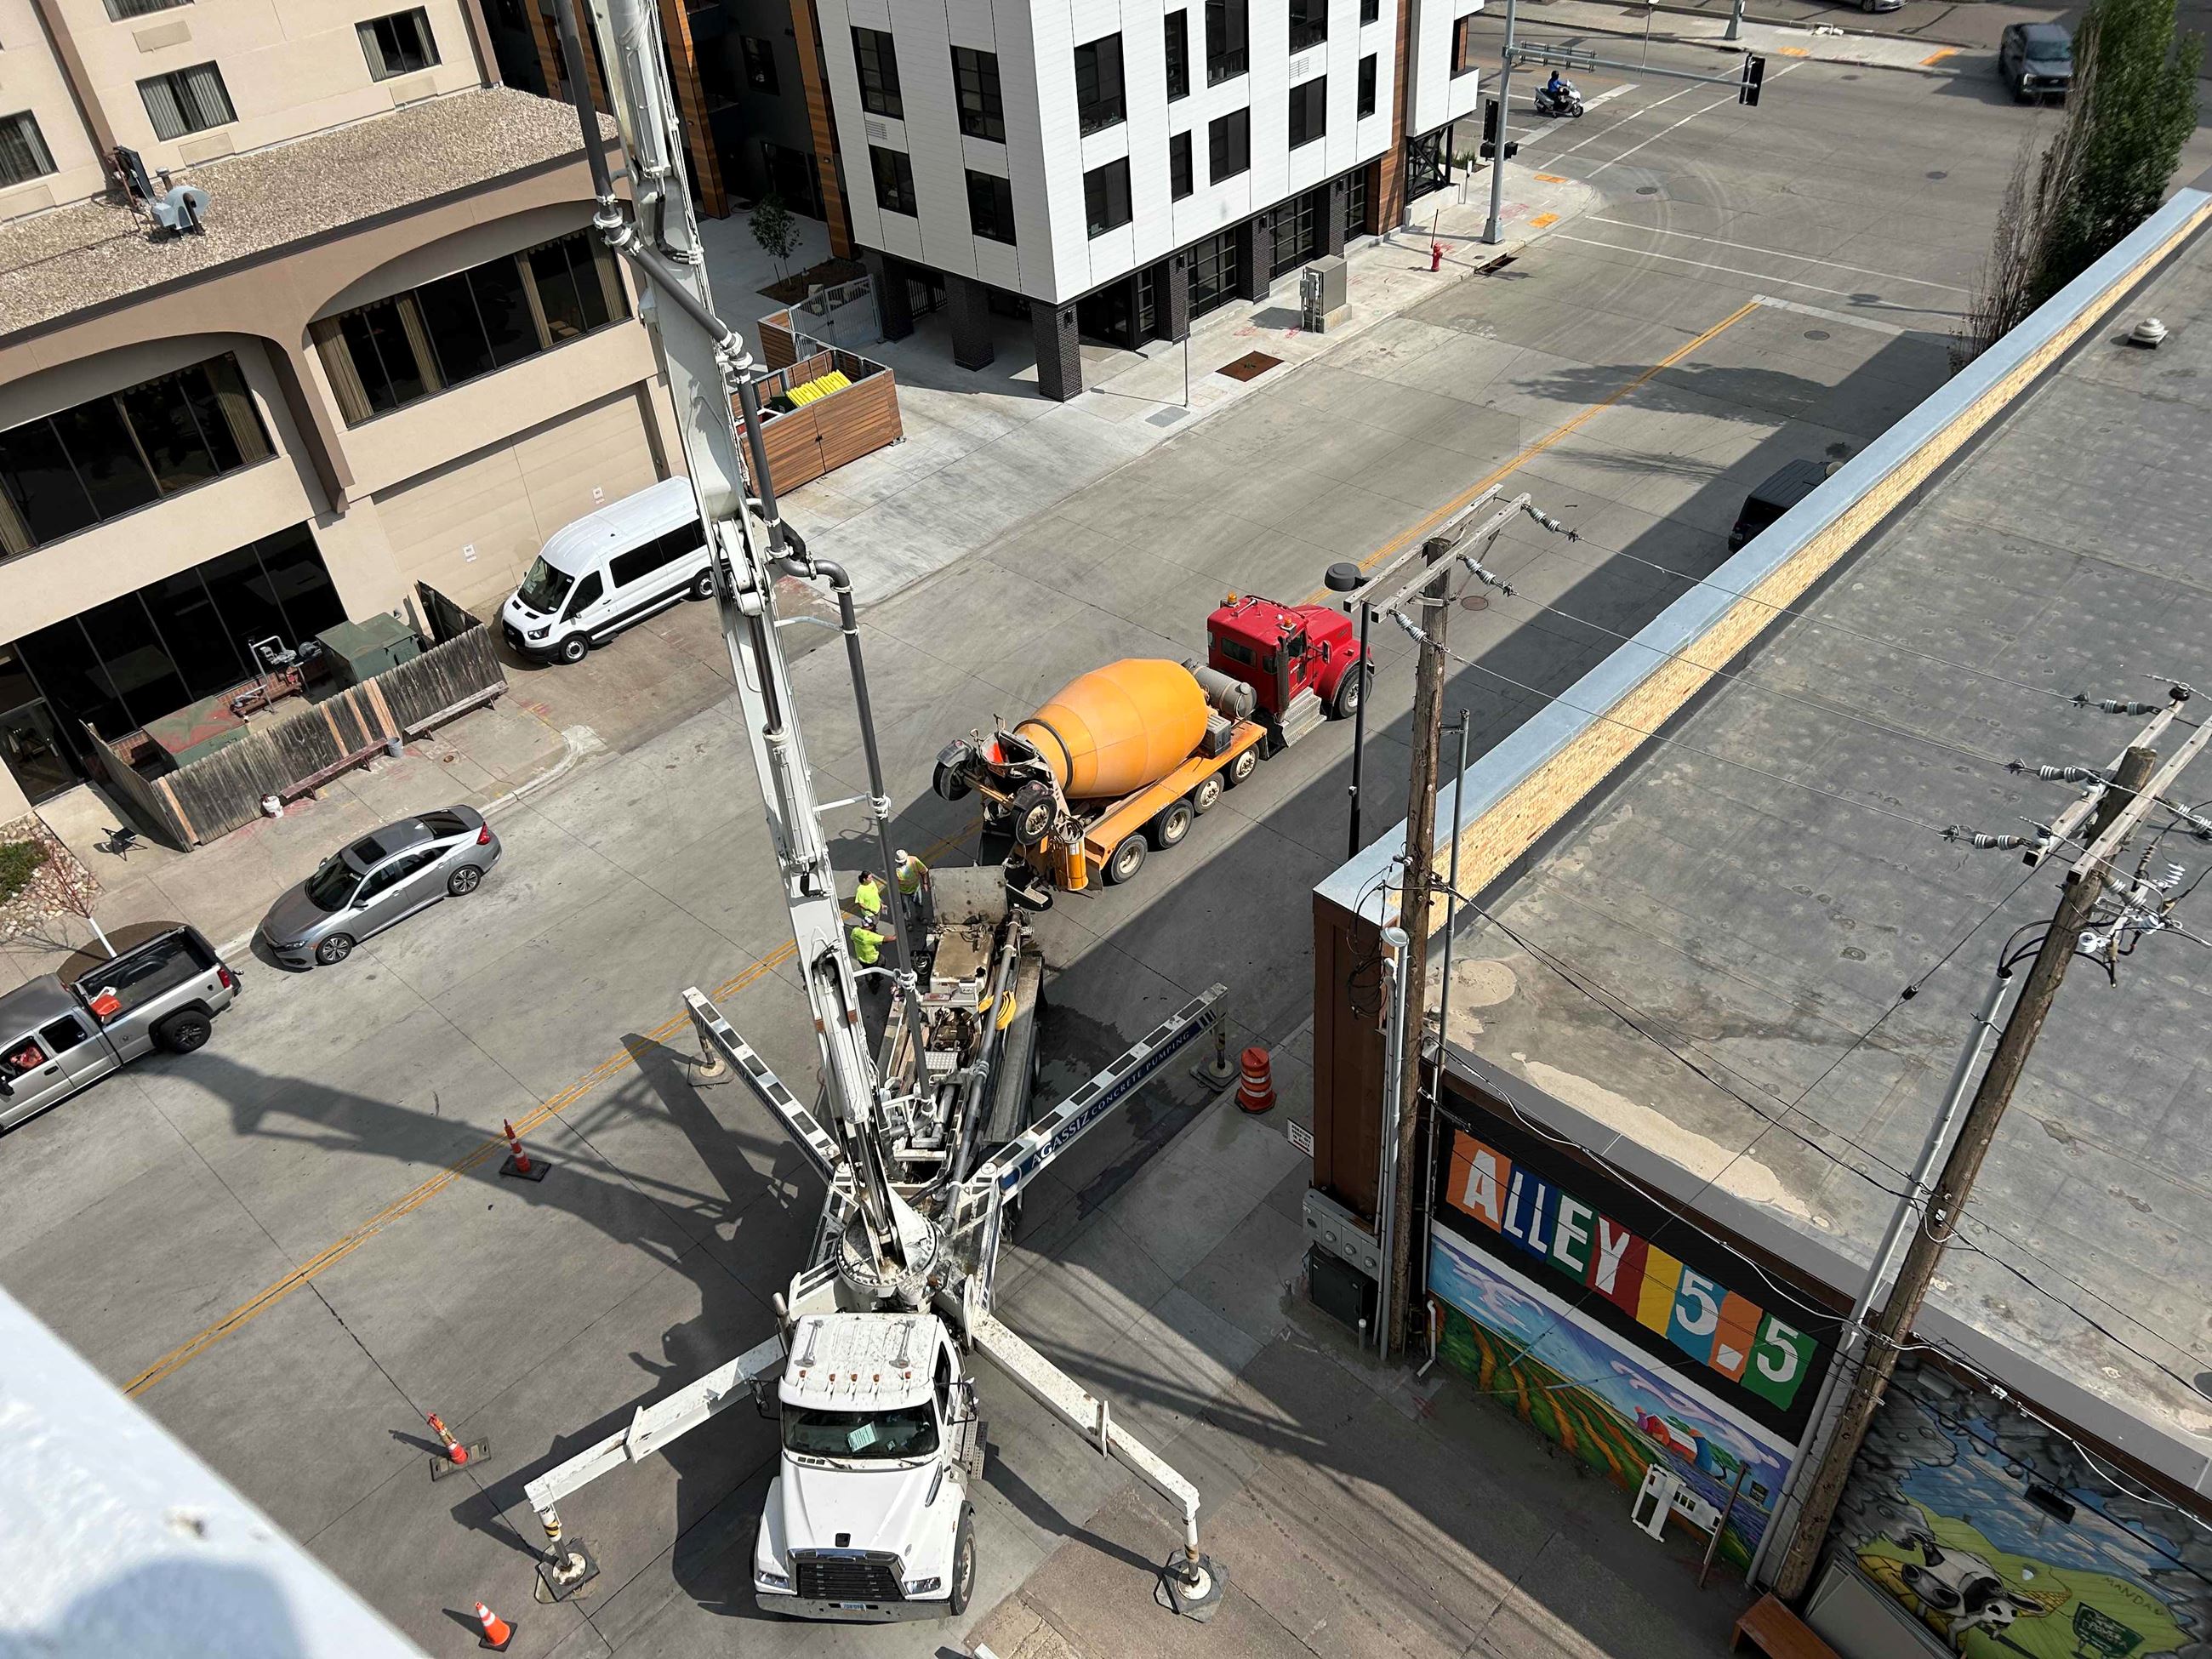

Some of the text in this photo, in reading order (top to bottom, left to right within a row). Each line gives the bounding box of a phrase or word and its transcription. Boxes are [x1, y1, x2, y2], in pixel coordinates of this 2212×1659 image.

[1030, 1029, 1190, 1169] AGASSIZ CONCRETE PUMPING
[1462, 1149, 1800, 1382] ALLEY 5.5
